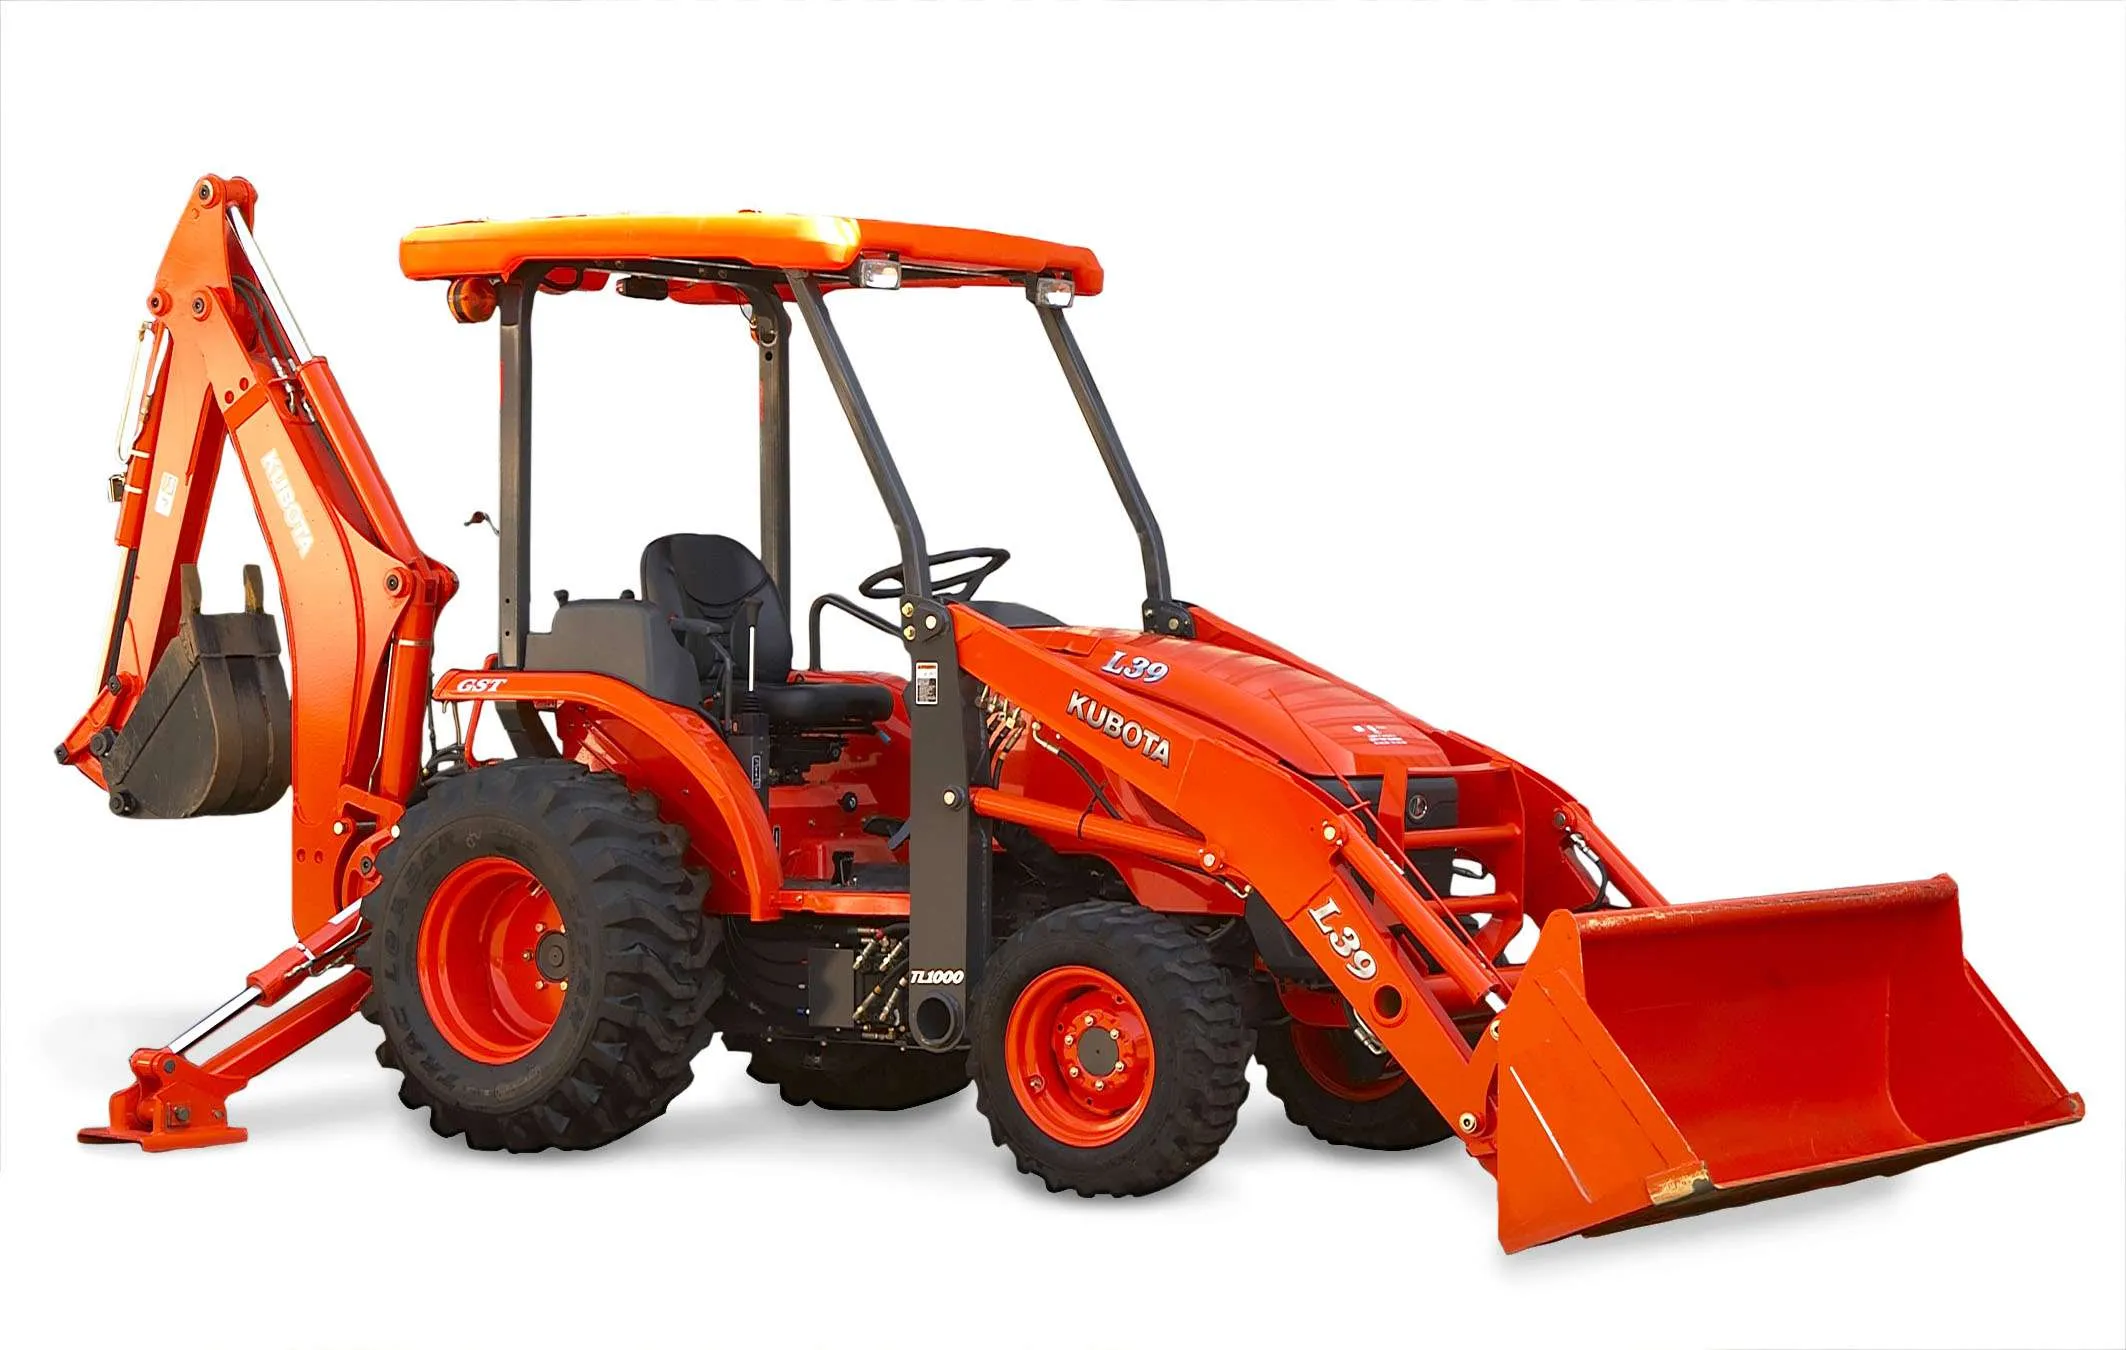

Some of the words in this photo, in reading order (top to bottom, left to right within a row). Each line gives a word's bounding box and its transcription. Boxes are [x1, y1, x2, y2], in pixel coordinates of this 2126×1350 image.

[260, 448, 314, 560] KUBOTA
[457, 678, 508, 693] GST
[1101, 650, 1169, 683] L39
[1066, 689, 1170, 768] KUBOTA
[1307, 896, 1377, 979] L39
[910, 969, 964, 985] TL1000
